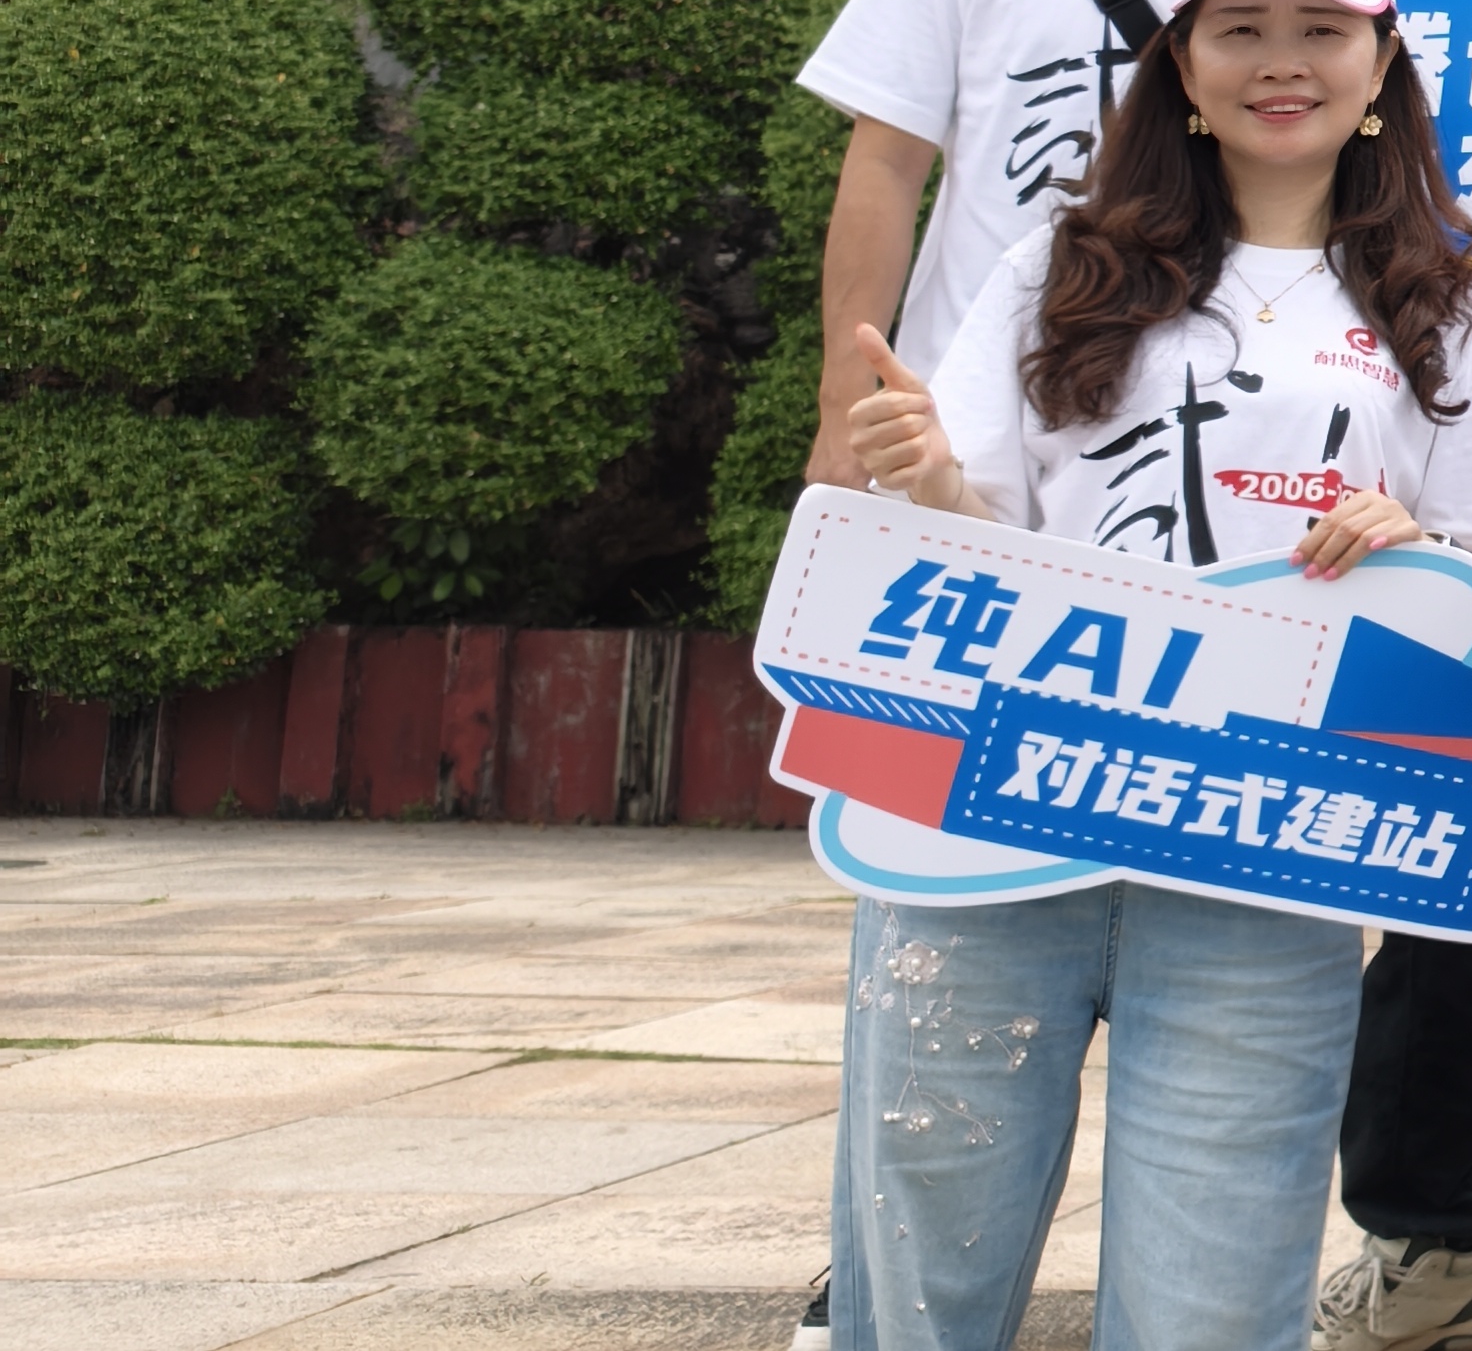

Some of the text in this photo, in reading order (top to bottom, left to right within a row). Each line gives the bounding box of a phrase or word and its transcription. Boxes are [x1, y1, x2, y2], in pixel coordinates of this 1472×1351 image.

[1314, 350, 1400, 392] 耐思智慧
[858, 557, 1206, 711] 纯AI
[997, 730, 1466, 879] 对话式建站
